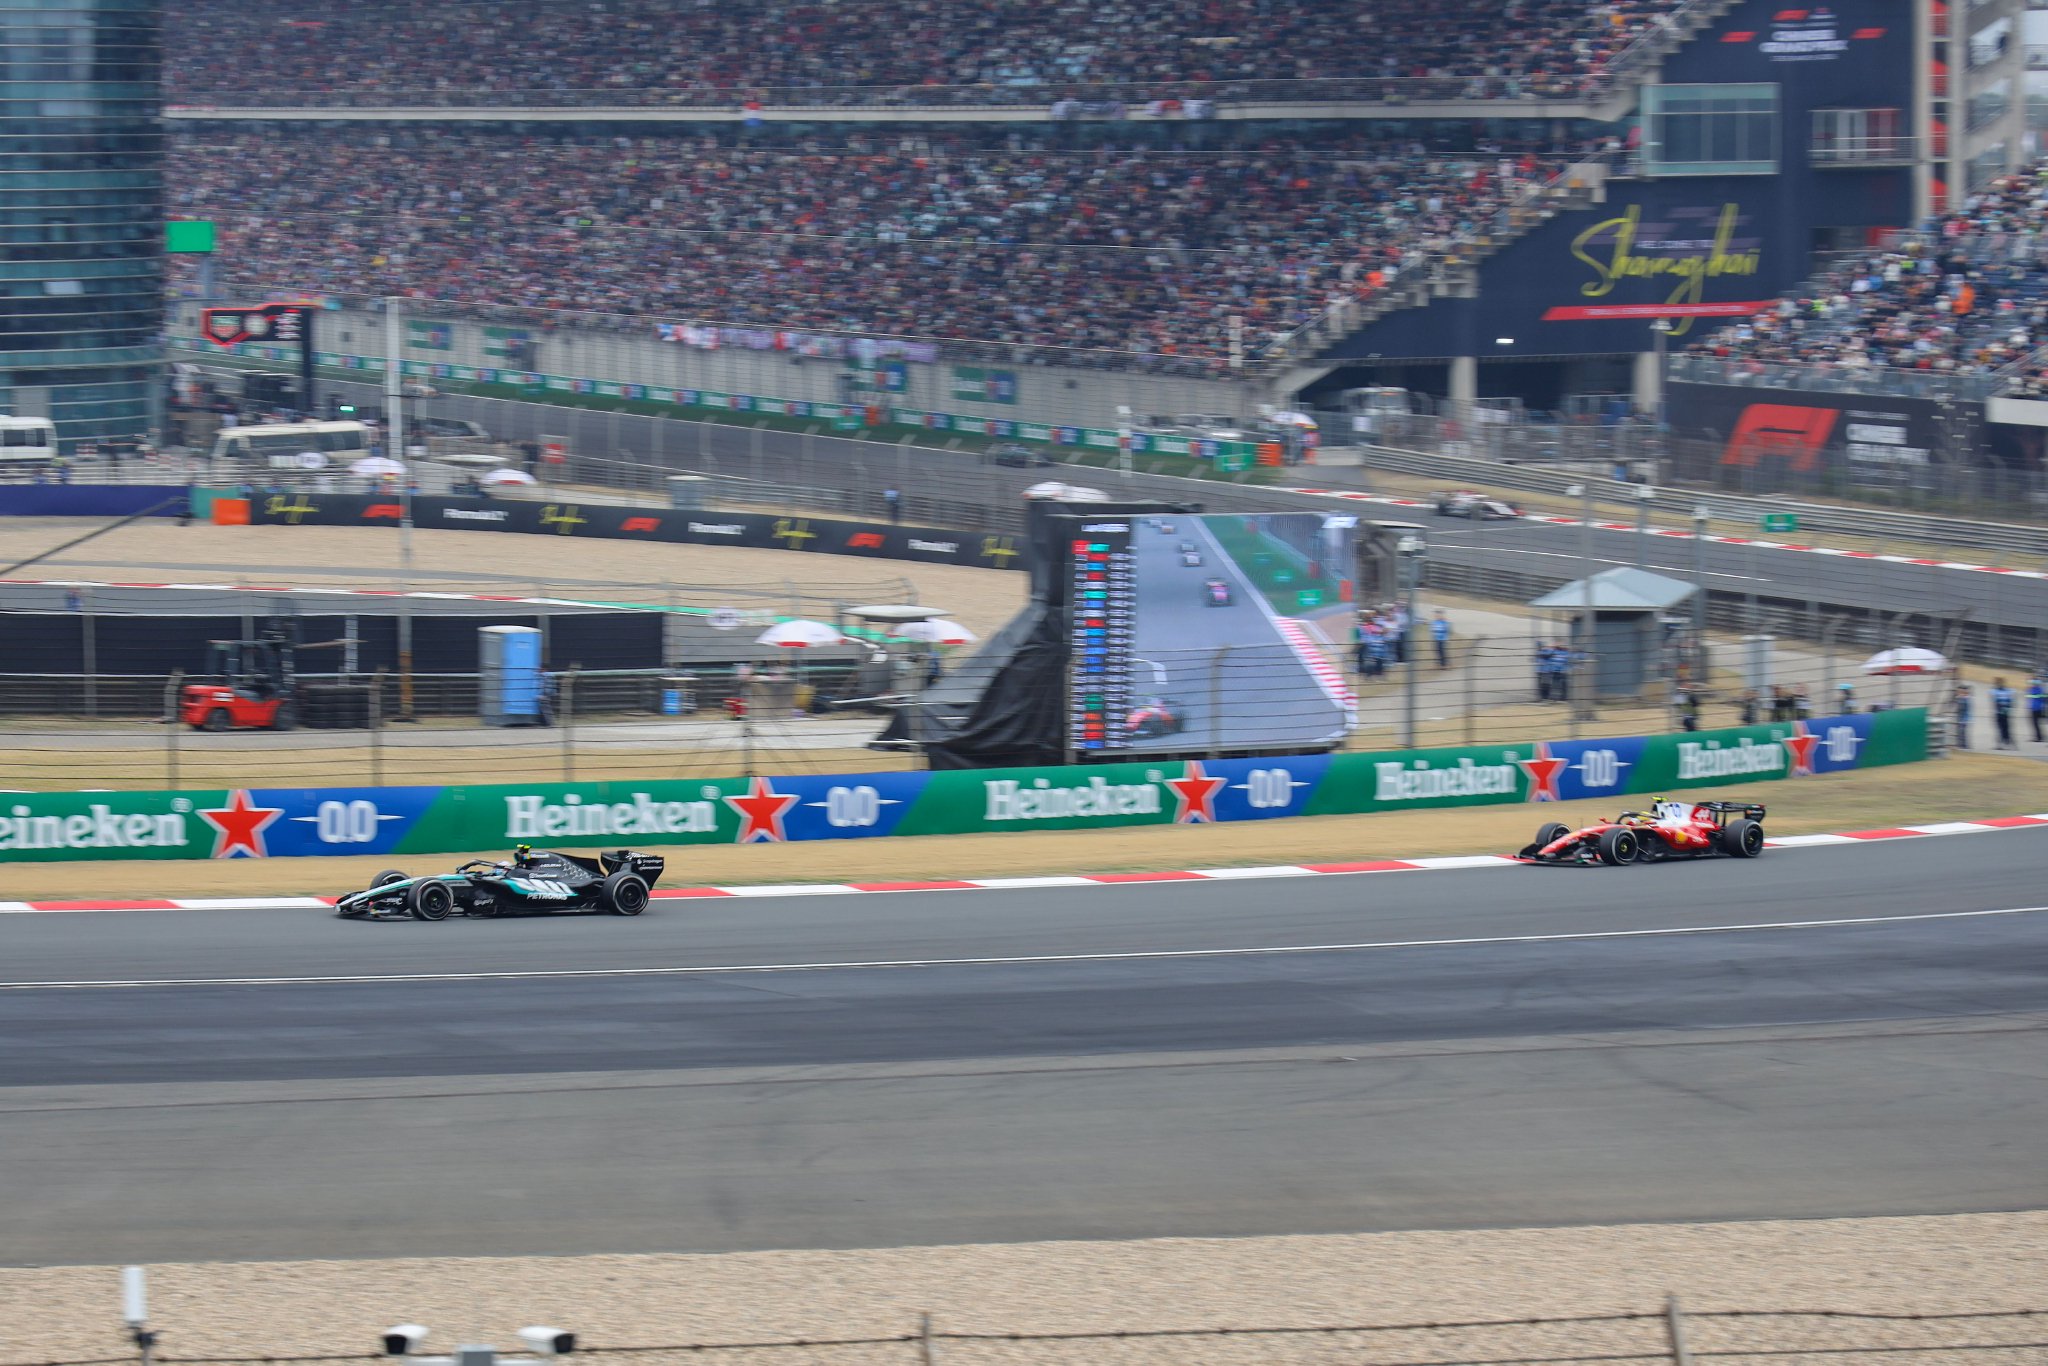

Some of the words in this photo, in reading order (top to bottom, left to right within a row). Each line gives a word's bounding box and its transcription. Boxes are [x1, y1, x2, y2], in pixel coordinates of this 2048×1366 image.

[984, 776, 1161, 820] Heineken
[1374, 758, 1516, 800] Heineken
[504, 793, 718, 838] Heineken
[527, 891, 568, 901] PETRONAS
